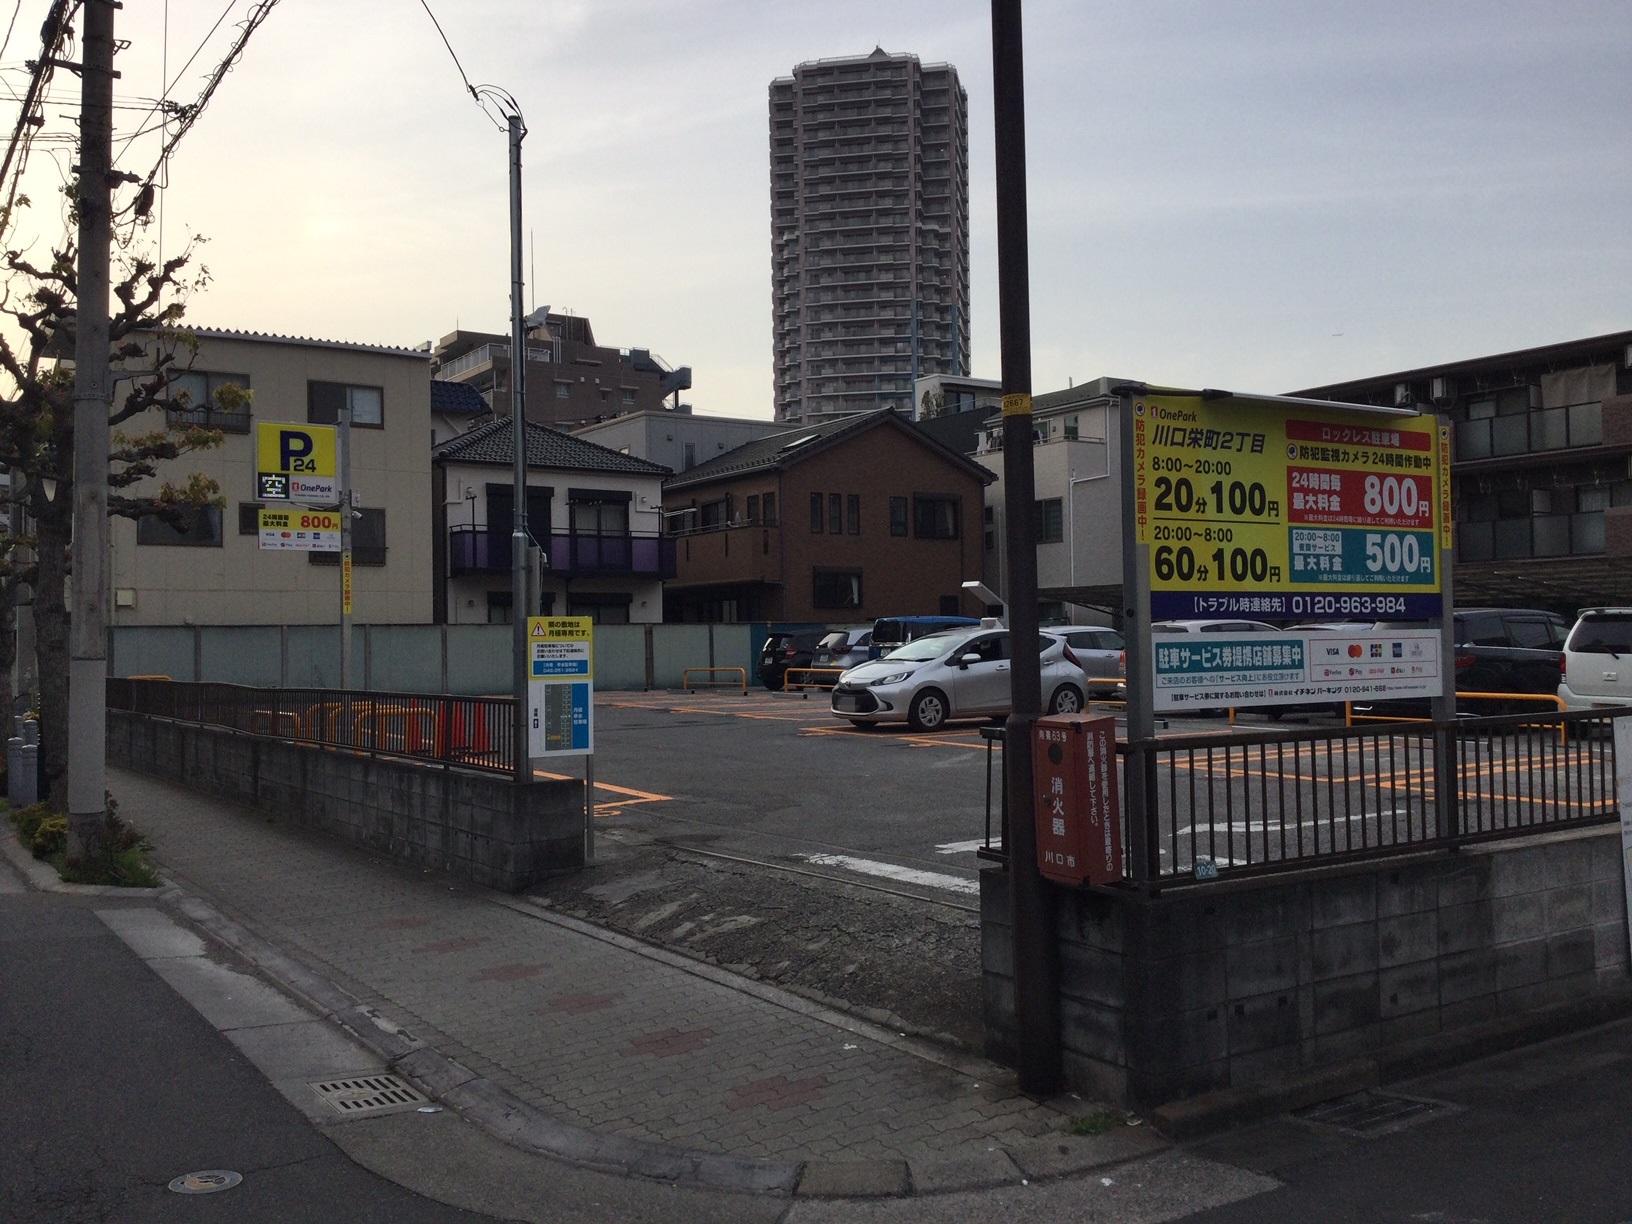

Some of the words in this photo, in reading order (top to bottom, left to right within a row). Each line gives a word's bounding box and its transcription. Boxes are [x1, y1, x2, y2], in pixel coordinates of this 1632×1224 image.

[1160, 408, 1196, 422] OnePark
[1152, 424, 1266, 454] 川口栄町2丁目
[1322, 428, 1400, 446] ロックレス駐車場
[280, 430, 313, 471] P
[294, 459, 316, 472] 24
[262, 474, 286, 498] 空
[300, 484, 332, 492] OnePark
[1292, 493, 1341, 512] 最大料金
[1364, 475, 1429, 517] 800円
[300, 516, 338, 529] 800円
[1294, 556, 1342, 571] 最大料金
[1366, 533, 1431, 572] 500円
[1292, 596, 1406, 613] 0120-963-984
[1050, 776, 1065, 836] 消火器
[1045, 850, 1075, 868] 川口市
